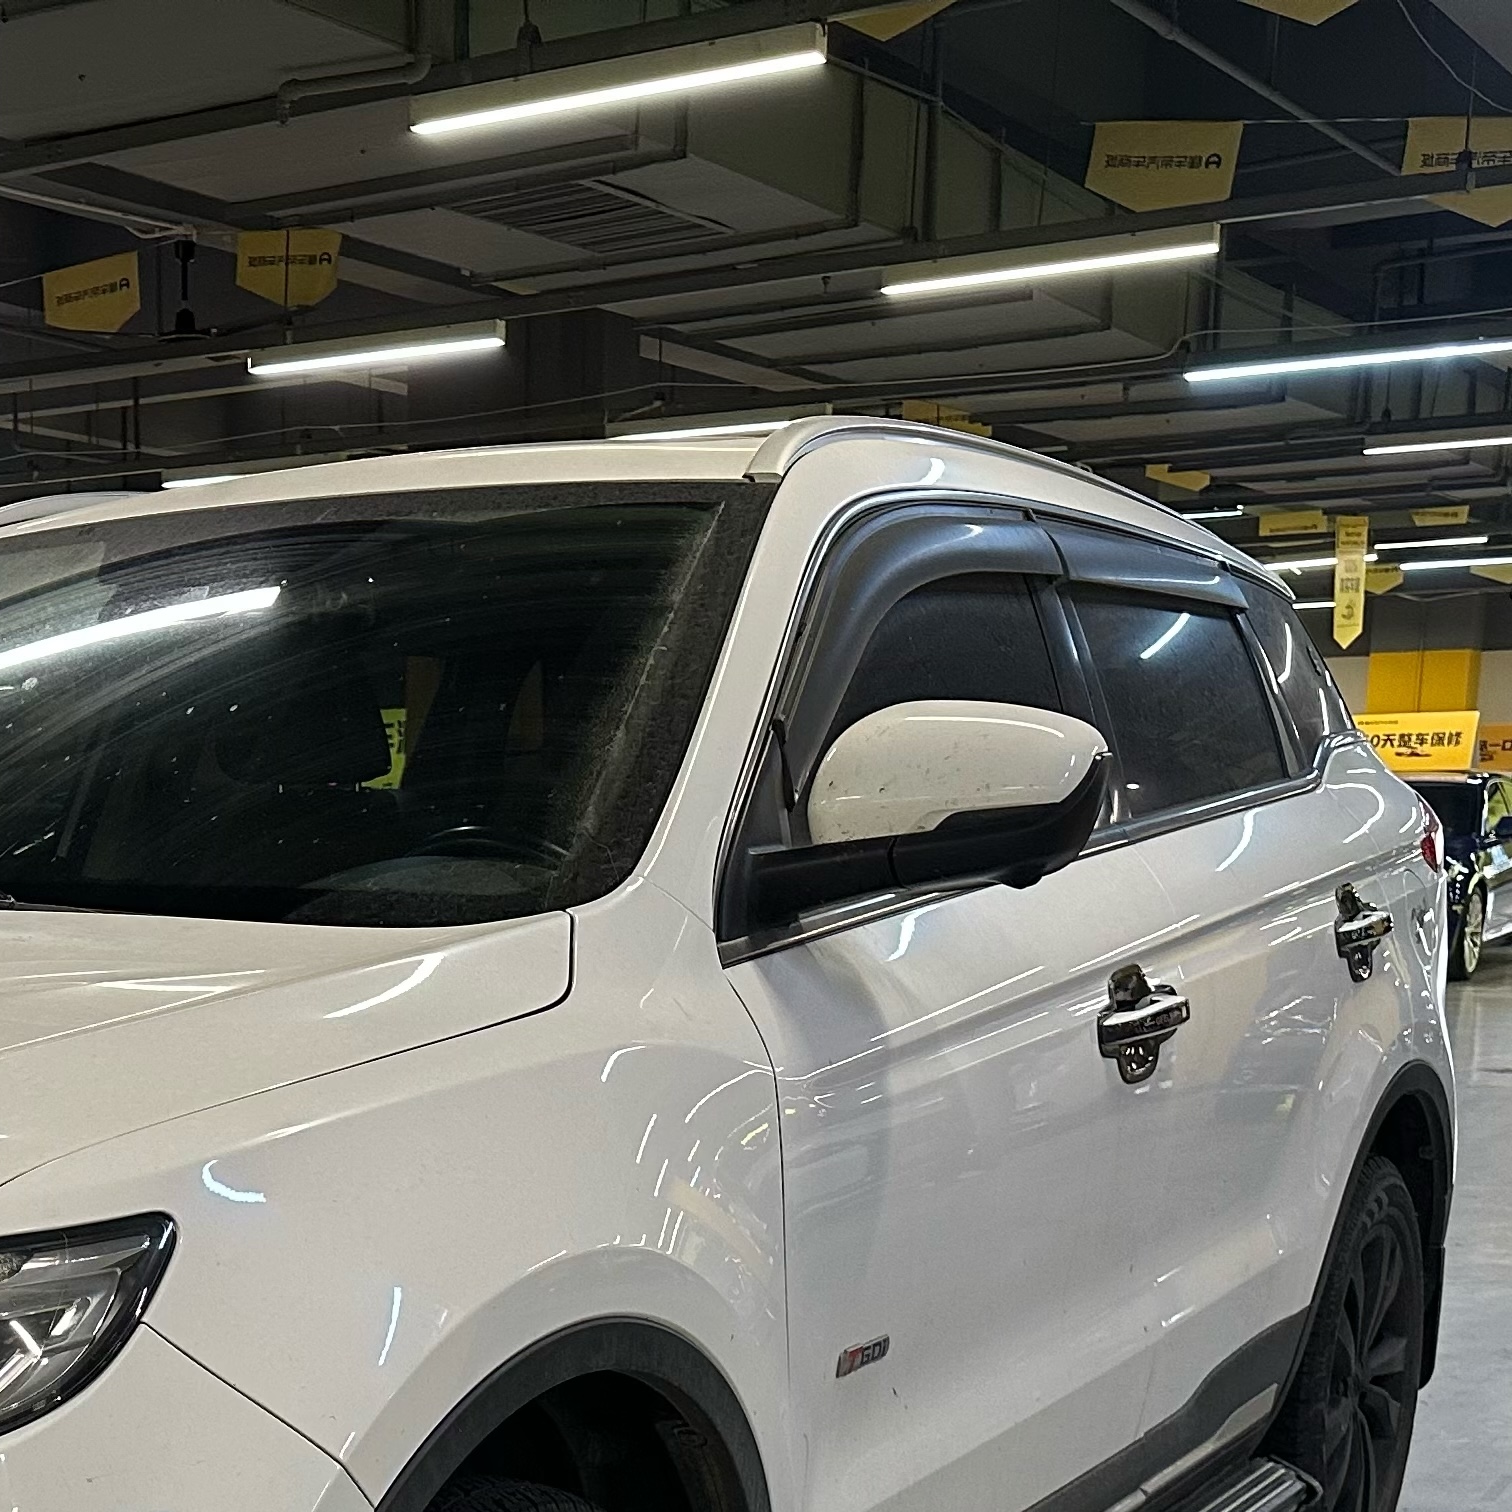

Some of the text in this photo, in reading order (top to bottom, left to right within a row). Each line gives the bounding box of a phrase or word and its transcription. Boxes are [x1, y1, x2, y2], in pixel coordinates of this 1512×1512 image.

[1368, 731, 1463, 748] 0天整车保修
